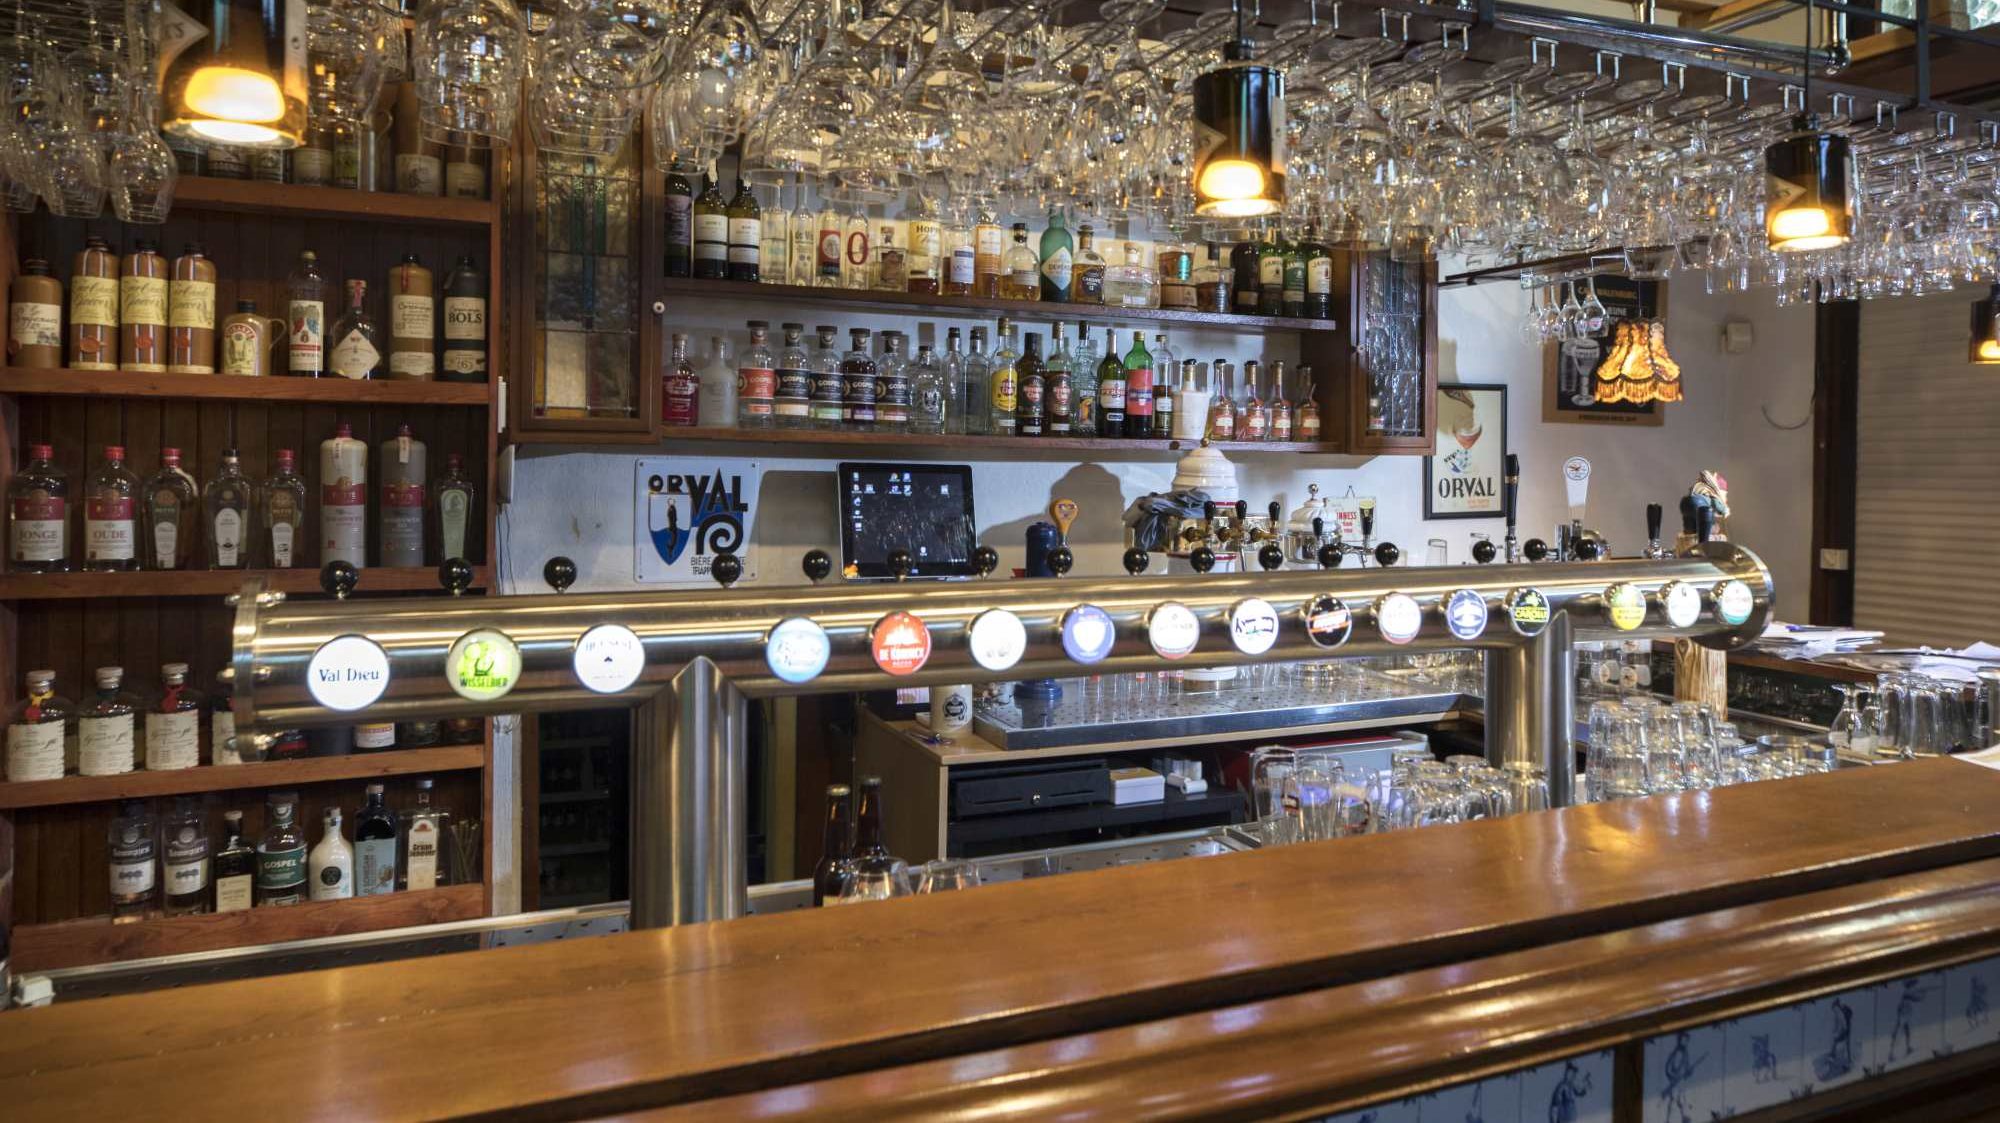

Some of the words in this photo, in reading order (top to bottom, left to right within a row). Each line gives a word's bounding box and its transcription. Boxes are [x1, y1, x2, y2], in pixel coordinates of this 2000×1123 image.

[448, 312, 482, 323] BOLS
[648, 467, 748, 515] ORVAL
[1438, 477, 1496, 499] ORVAL
[20, 529, 57, 541] JONGE
[93, 529, 128, 540] OUDE
[319, 669, 341, 683] Val
[347, 667, 380, 682] Dieu
[263, 859, 296, 869] GOSPEL
